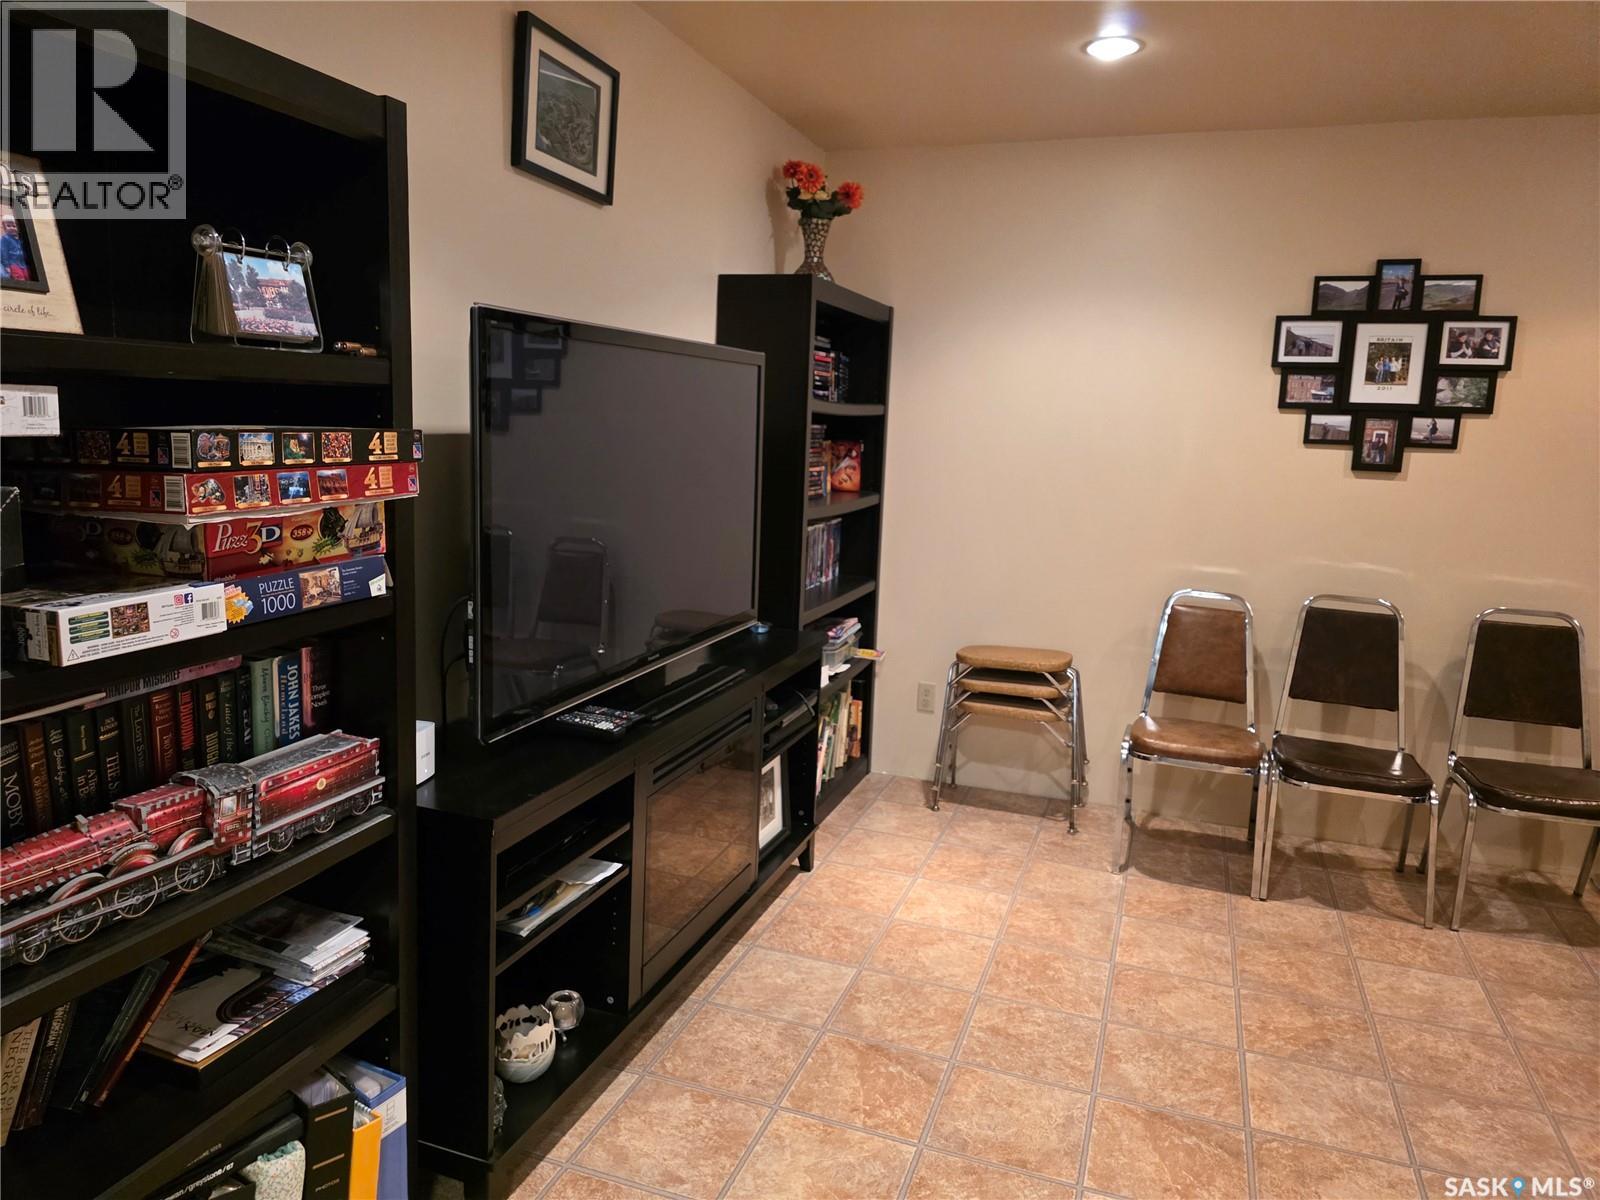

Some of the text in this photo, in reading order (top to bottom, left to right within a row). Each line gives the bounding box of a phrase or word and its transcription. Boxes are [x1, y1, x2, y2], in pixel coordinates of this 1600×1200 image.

[369, 431, 383, 454] 4
[363, 467, 378, 489] 4
[258, 577, 295, 595] PUZZLE
[261, 593, 296, 615] 1000
[287, 664, 301, 740] JOHN JAKES
[3, 771, 25, 829] MOBY
[5, 1029, 33, 1112] THE BOOK OF
